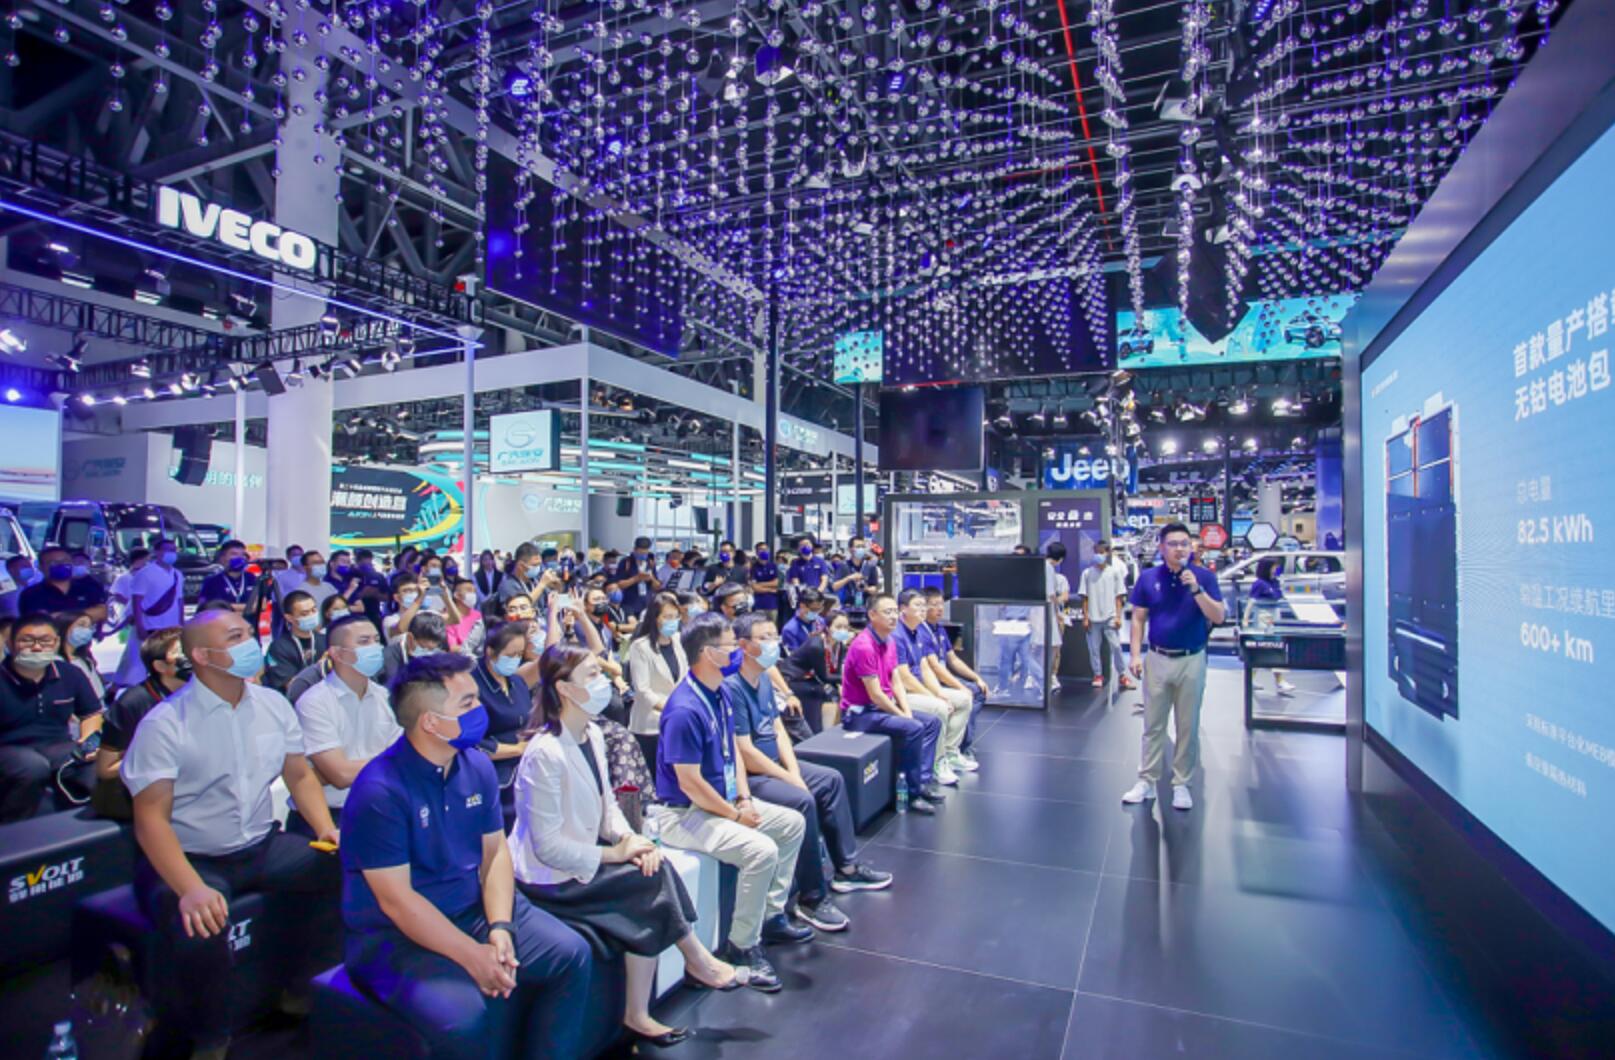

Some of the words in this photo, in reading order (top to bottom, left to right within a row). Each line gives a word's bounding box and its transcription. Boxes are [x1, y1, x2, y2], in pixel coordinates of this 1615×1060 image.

[159, 185, 316, 270] IVECO
[1513, 287, 1615, 378] 首款量产搭
[1517, 517, 1550, 544] 82.5
[1553, 512, 1594, 544] kWh
[1520, 621, 1561, 653] 600+
[1564, 629, 1594, 664] km
[9, 856, 85, 893] SVOLT
